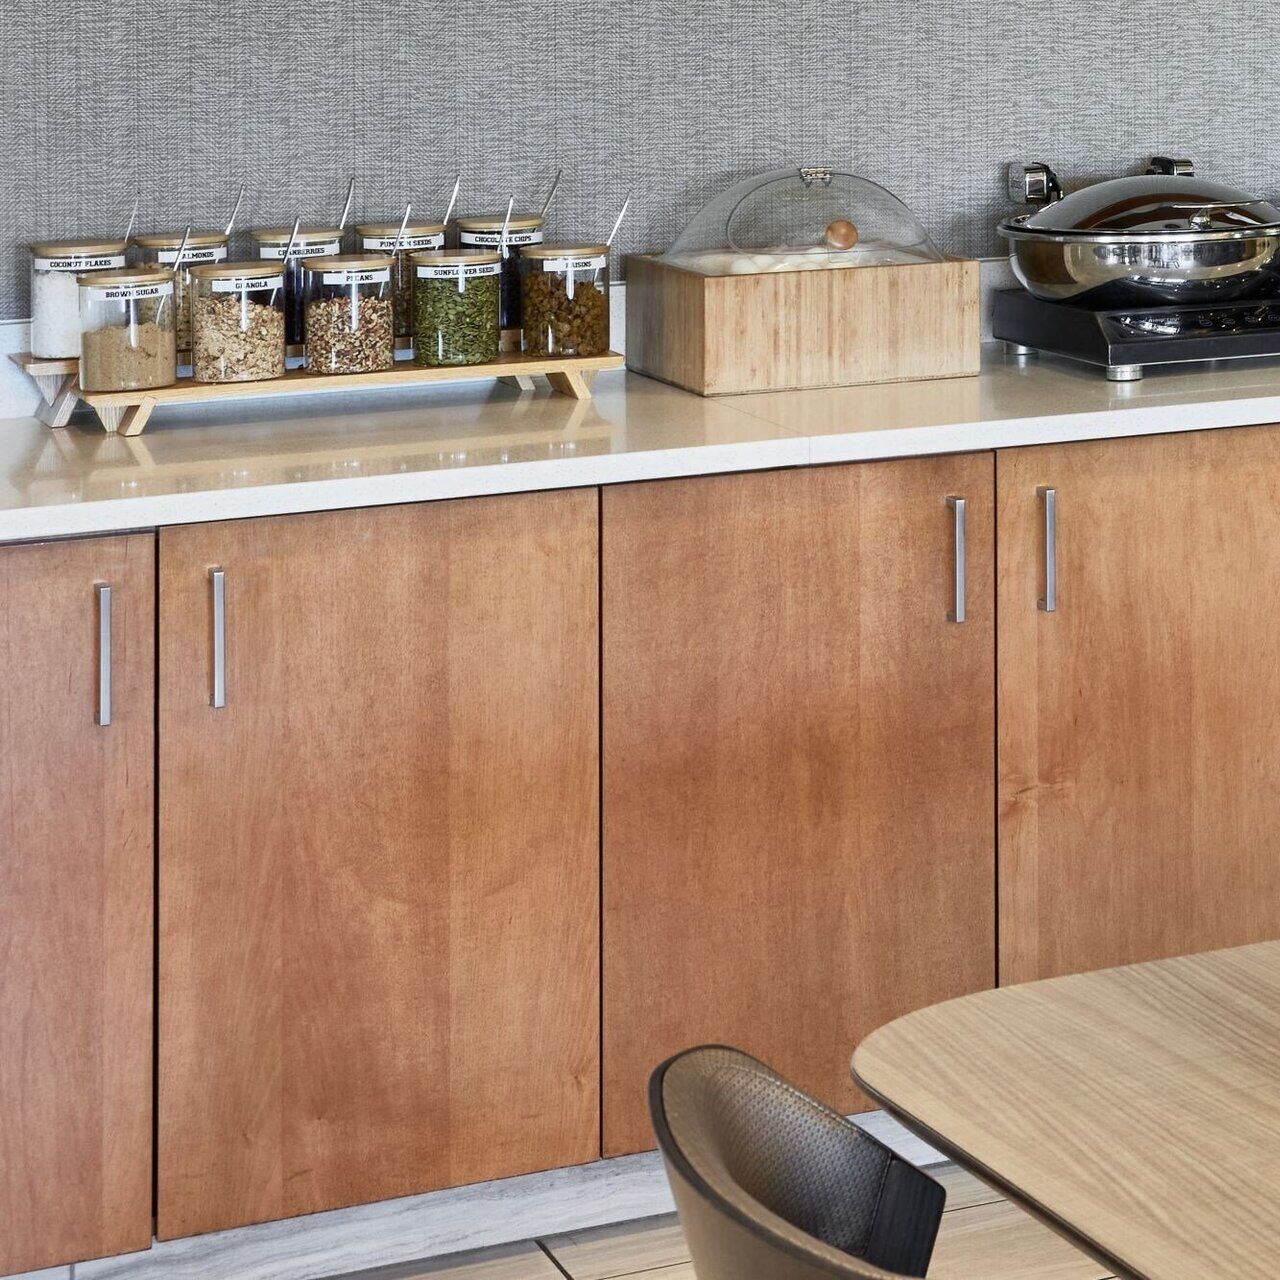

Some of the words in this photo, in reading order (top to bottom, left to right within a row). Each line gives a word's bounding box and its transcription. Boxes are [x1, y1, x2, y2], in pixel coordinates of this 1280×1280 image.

[181, 252, 214, 260] ALMONDS
[50, 260, 82, 268] COCONUT
[84, 259, 112, 267] FLAKES
[478, 266, 495, 274] SEEDS
[235, 281, 269, 289] GANOLA
[135, 288, 159, 296] SUGAR
